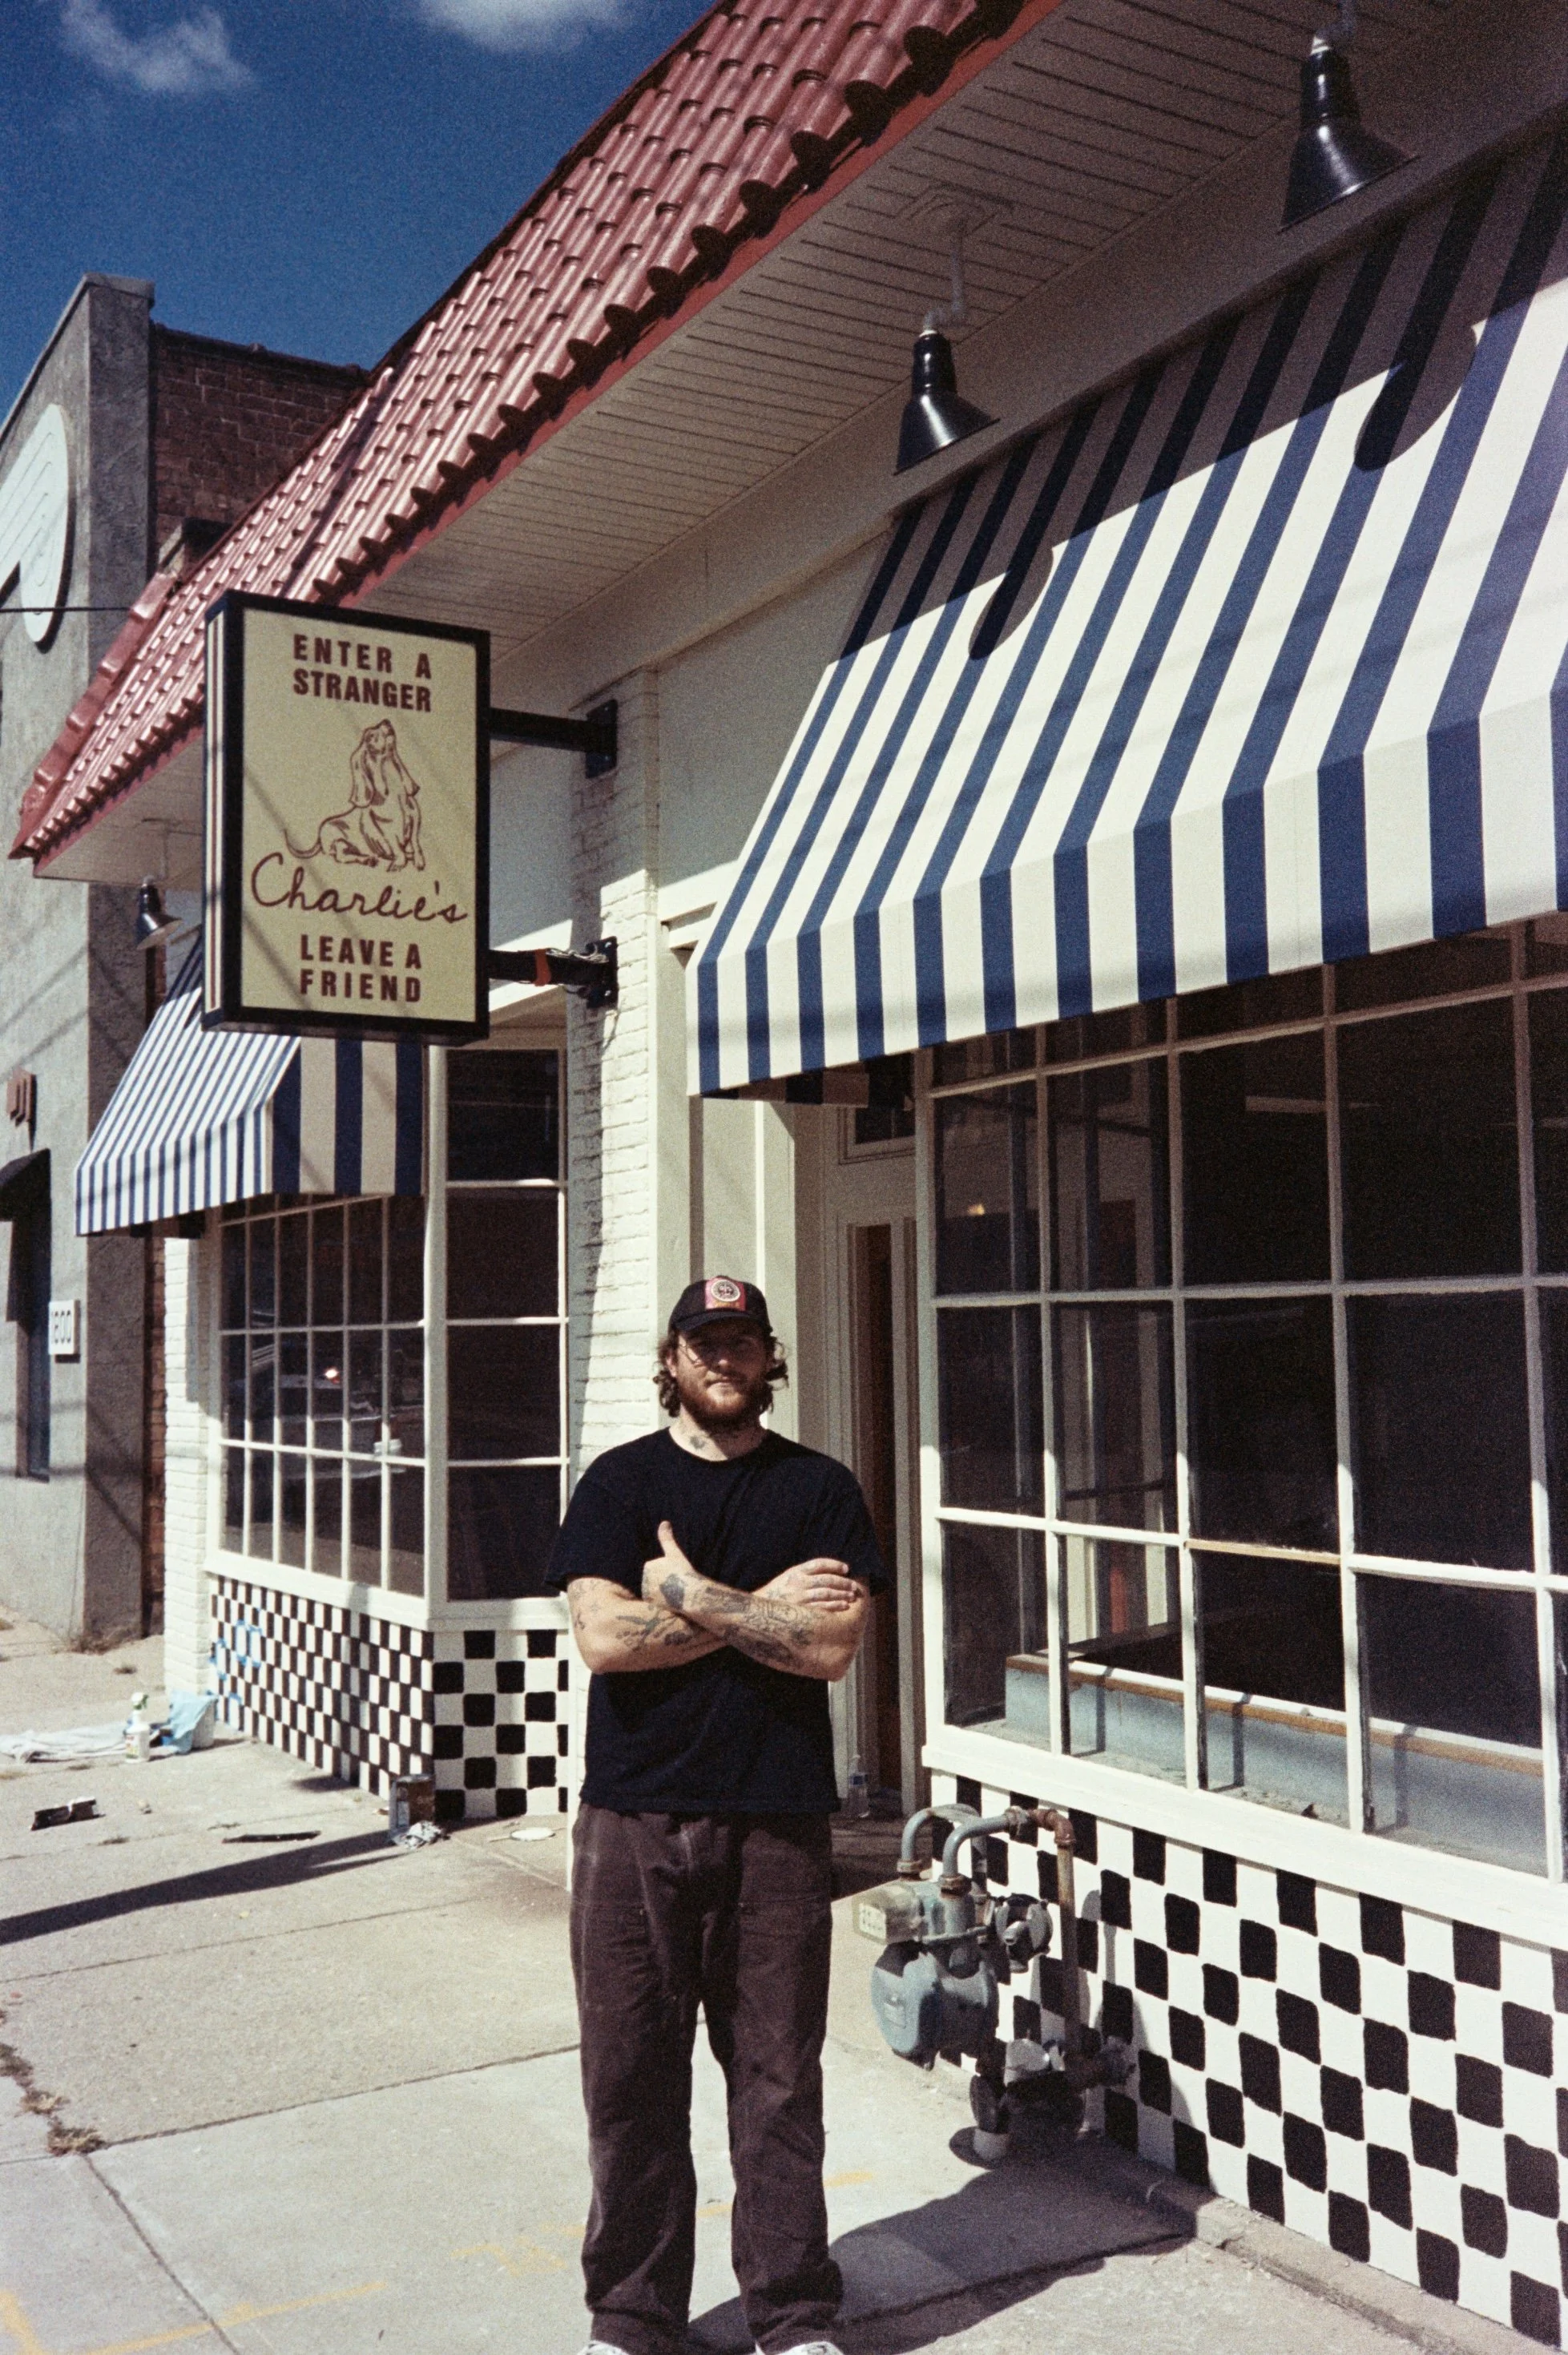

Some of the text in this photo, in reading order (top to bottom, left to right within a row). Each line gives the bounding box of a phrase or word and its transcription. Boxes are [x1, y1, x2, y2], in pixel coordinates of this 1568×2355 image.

[293, 633, 432, 679] ENTER A
[293, 667, 431, 712] STRANGER
[250, 852, 469, 924] Charlie's
[300, 934, 422, 970] LEAVE A
[300, 969, 421, 1003] FRIEND
